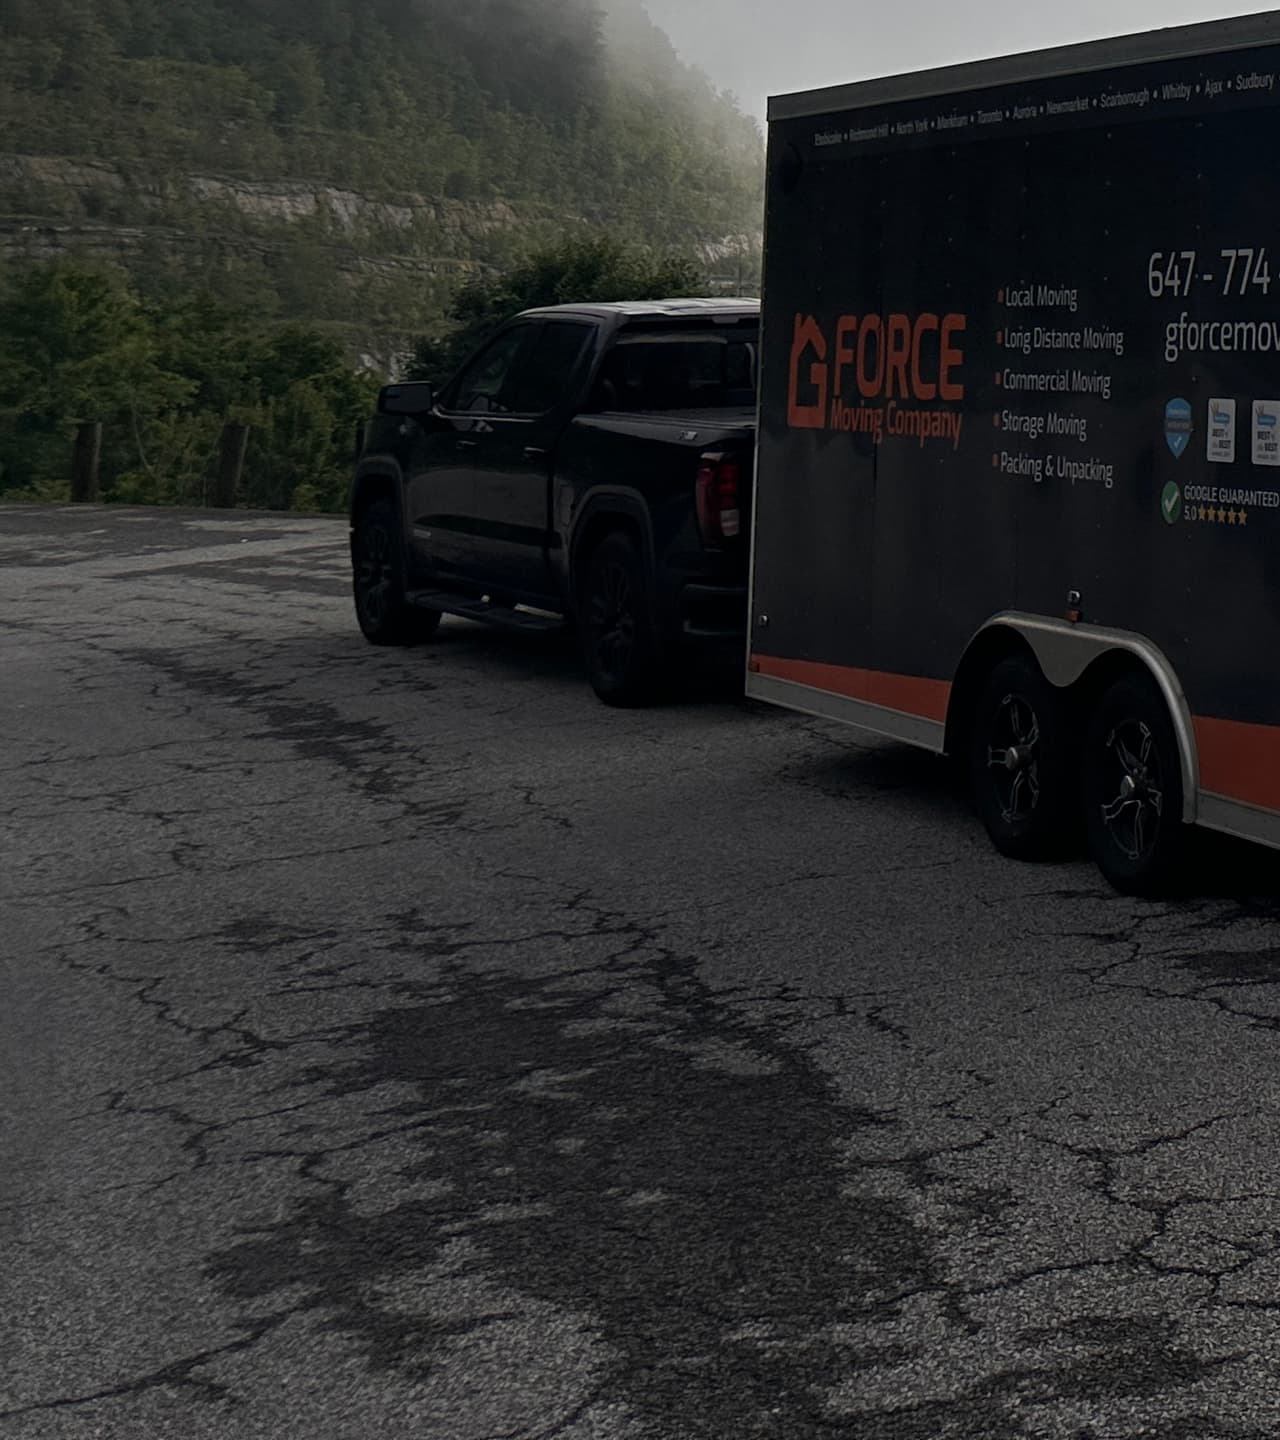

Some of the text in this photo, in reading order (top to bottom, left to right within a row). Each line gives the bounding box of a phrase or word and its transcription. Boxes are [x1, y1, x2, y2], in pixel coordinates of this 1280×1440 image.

[1100, 87, 1150, 109] Scarborough
[1162, 82, 1192, 101] Whitby
[1204, 79, 1223, 98] Ajax
[1236, 73, 1274, 96] Sudbury
[1148, 250, 1197, 297] 647
[1220, 247, 1271, 296] 774
[1005, 283, 1078, 312] Local Moving
[833, 312, 968, 400] FORCE
[1004, 326, 1124, 355] Long Distance Moving
[1003, 368, 1111, 399] Commercial Moving
[831, 398, 963, 451] Moving Company
[1001, 410, 1087, 442] Storage Moving
[1000, 451, 1113, 488] Packing & Unpacking
[1184, 484, 1280, 508] GOOGLE GUARANTEED
[1184, 505, 1197, 521] 5.0
